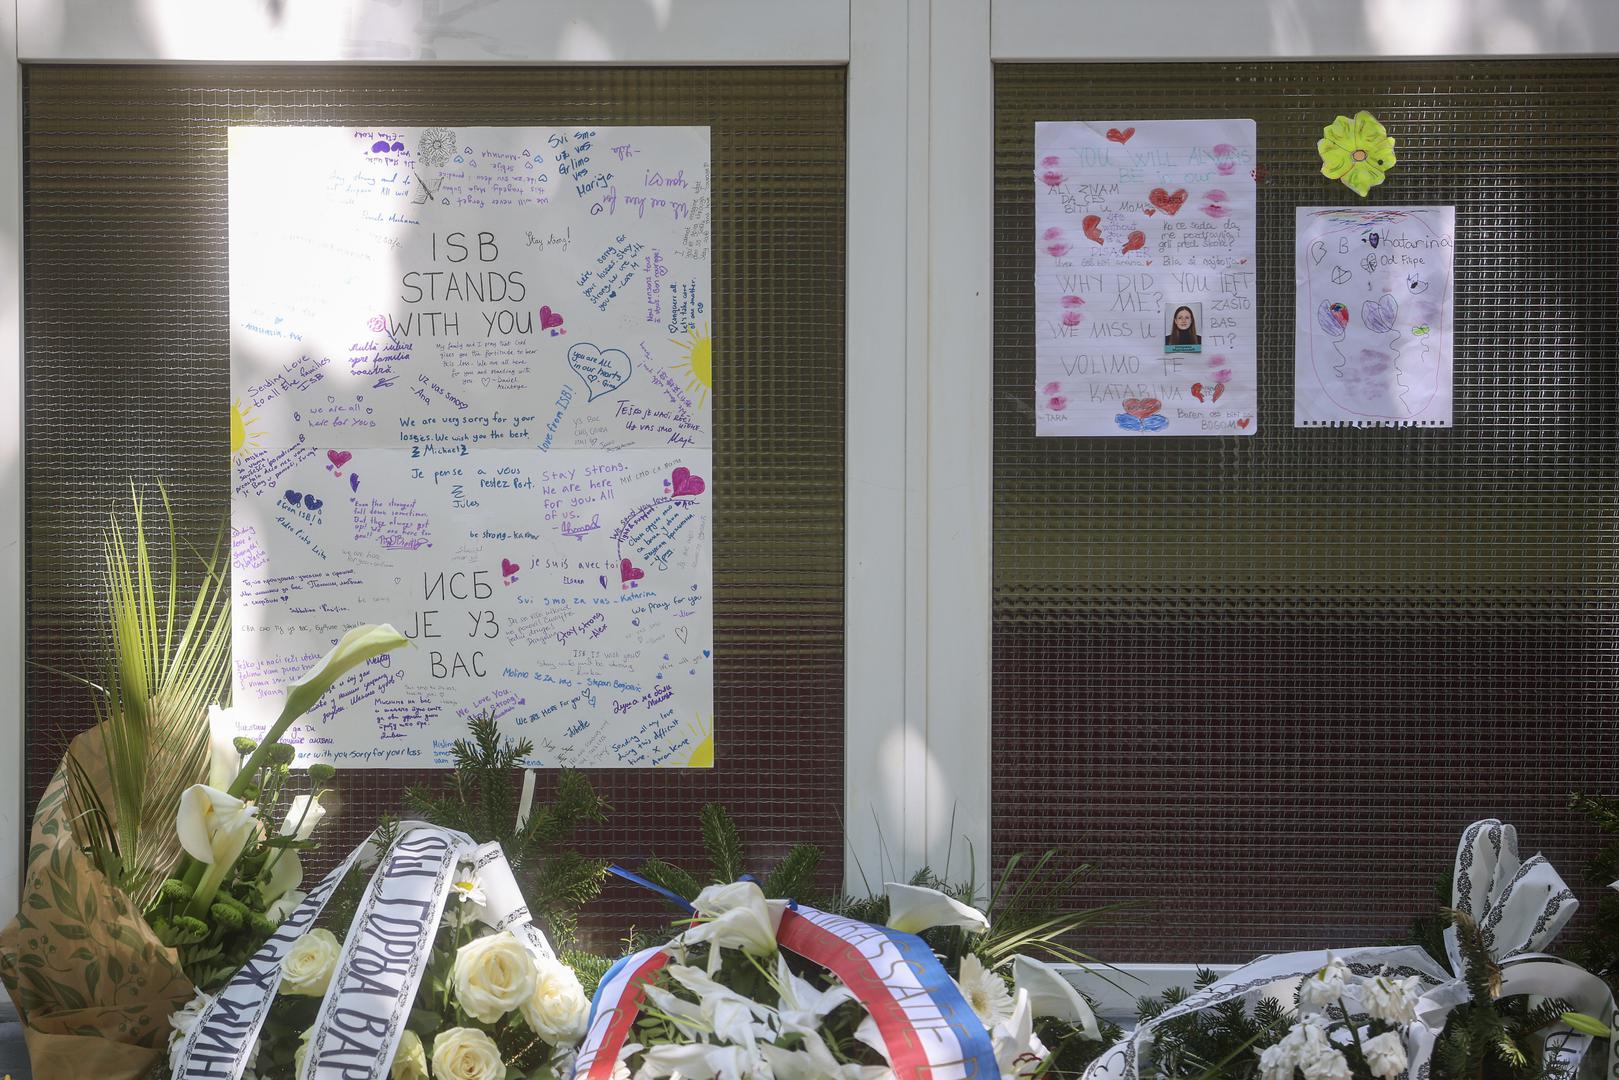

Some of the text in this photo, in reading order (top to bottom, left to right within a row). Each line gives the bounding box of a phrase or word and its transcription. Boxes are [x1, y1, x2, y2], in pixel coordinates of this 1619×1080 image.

[548, 133, 568, 149] Svi
[432, 231, 499, 263] ISB
[1381, 227, 1454, 249] Katarina
[401, 271, 526, 304] STANDS
[1055, 272, 1104, 293] WHY
[1116, 273, 1153, 293] DID
[1171, 271, 1210, 293] YOU
[1110, 289, 1164, 314] ME?
[389, 310, 533, 338] WITH YOU
[1089, 320, 1133, 339] MISS
[1139, 320, 1157, 339] U
[283, 355, 311, 373] Love
[1060, 354, 1185, 377] VOLIMO TE
[1089, 382, 1185, 405] KATARINA
[399, 416, 416, 427] We
[441, 417, 460, 427] very
[461, 416, 489, 427] sorry
[492, 411, 507, 424] for
[513, 415, 536, 428] your
[435, 433, 449, 441] We
[452, 432, 469, 441] wish
[472, 433, 487, 443] you
[490, 429, 504, 440] the
[411, 468, 425, 479] Je
[496, 467, 520, 475] vous
[543, 463, 628, 482] Stay strong.
[542, 479, 612, 495] We are here
[452, 499, 480, 509] Jules
[570, 493, 596, 507] you.
[600, 489, 615, 501] All
[543, 510, 580, 521] of us.
[578, 560, 600, 570] avec
[424, 570, 493, 600] ИСБ
[673, 595, 686, 605] for
[688, 596, 702, 606] you
[468, 610, 500, 638] УЗ
[556, 626, 579, 646] Stay
[579, 611, 605, 634] strong
[430, 650, 487, 679] ВАС
[313, 749, 332, 759] with
